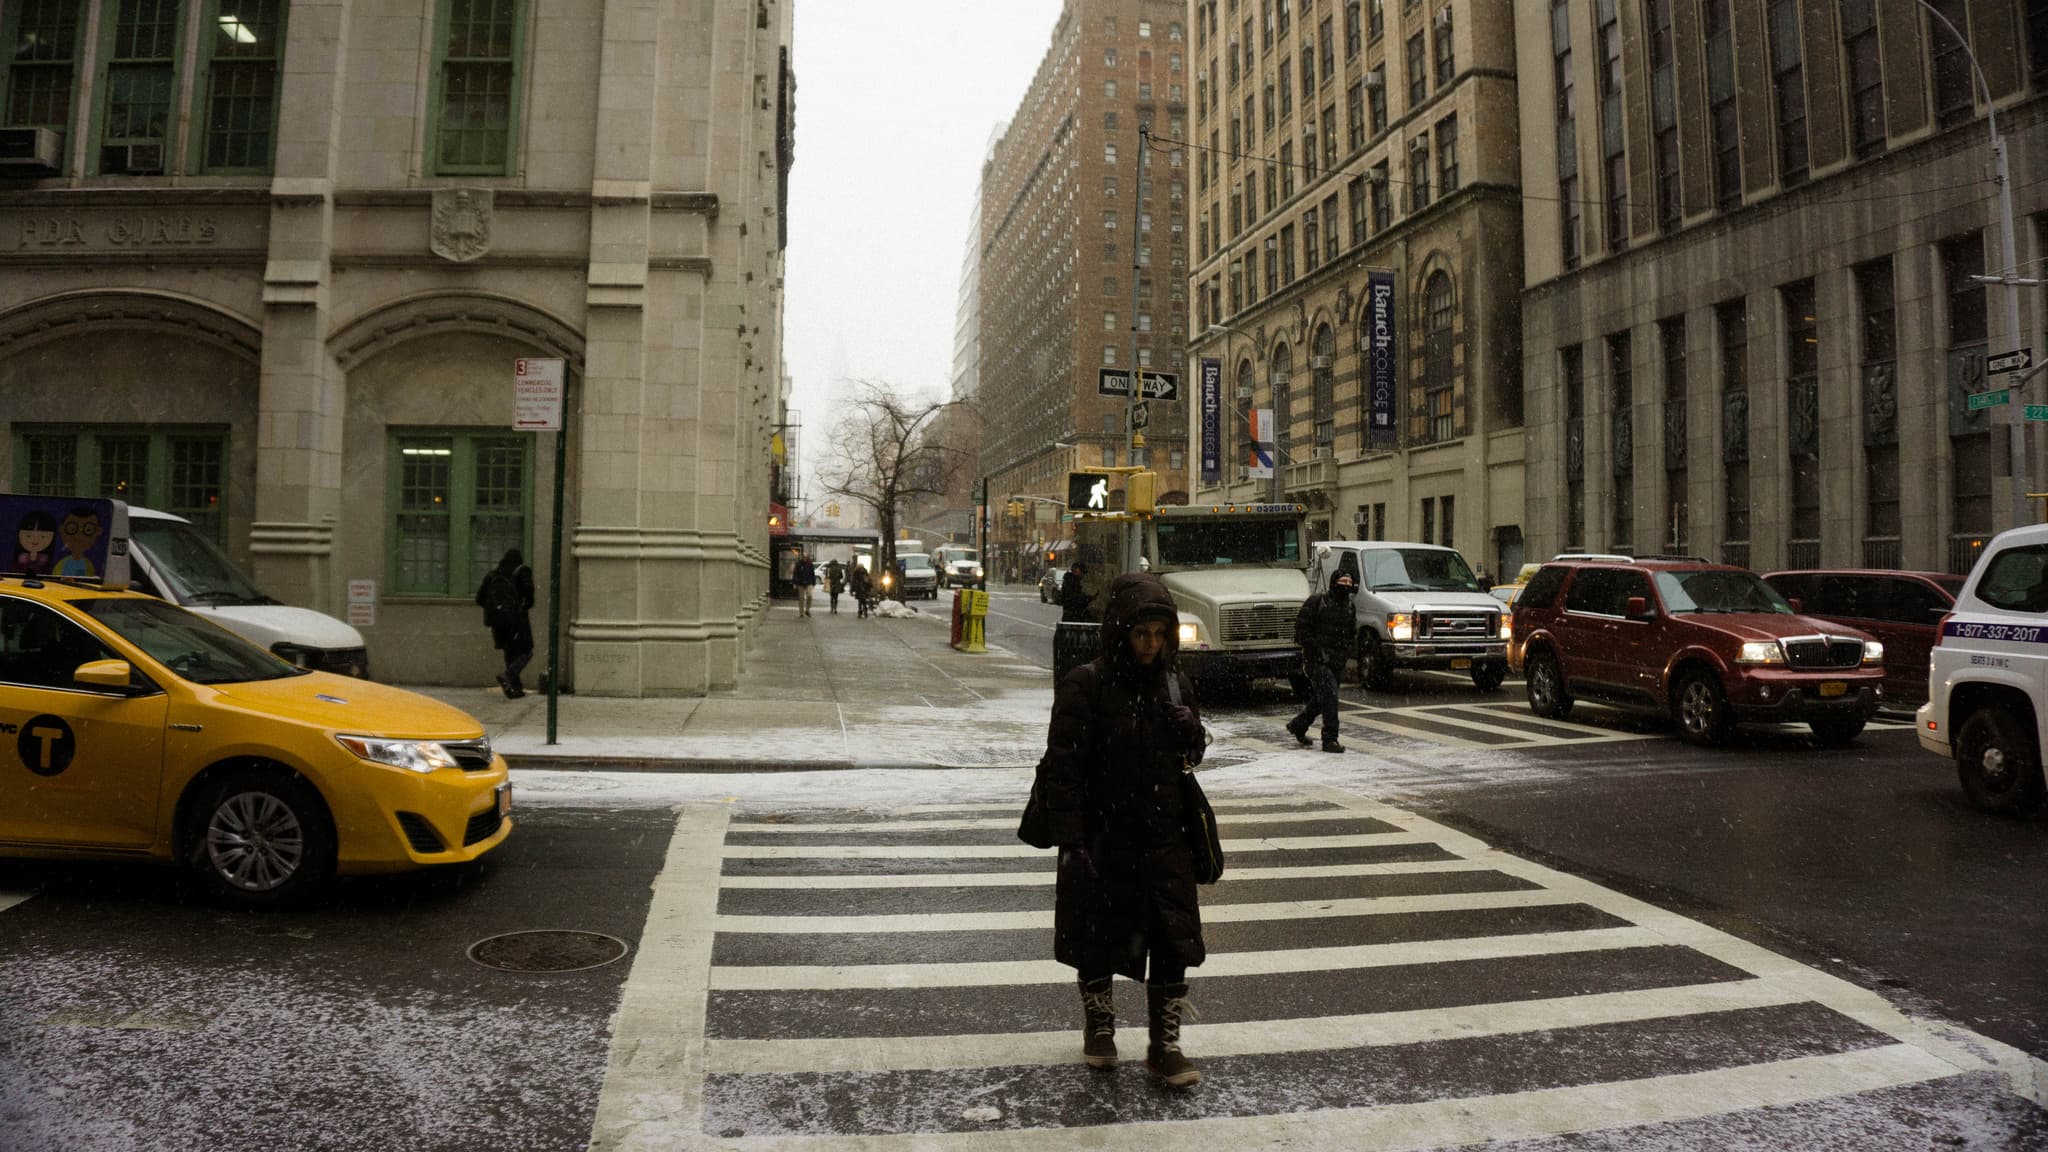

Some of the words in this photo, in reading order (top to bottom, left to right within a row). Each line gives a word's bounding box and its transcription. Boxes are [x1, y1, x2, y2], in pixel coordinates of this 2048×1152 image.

[517, 361, 526, 375] 3
[1992, 359, 2006, 369] ONE
[1110, 377, 1129, 389] ON
[1143, 380, 1166, 393] WAY
[2032, 406, 2043, 418] 22
[1955, 623, 2040, 641] 1-877-337-2017
[32, 726, 63, 768] T
